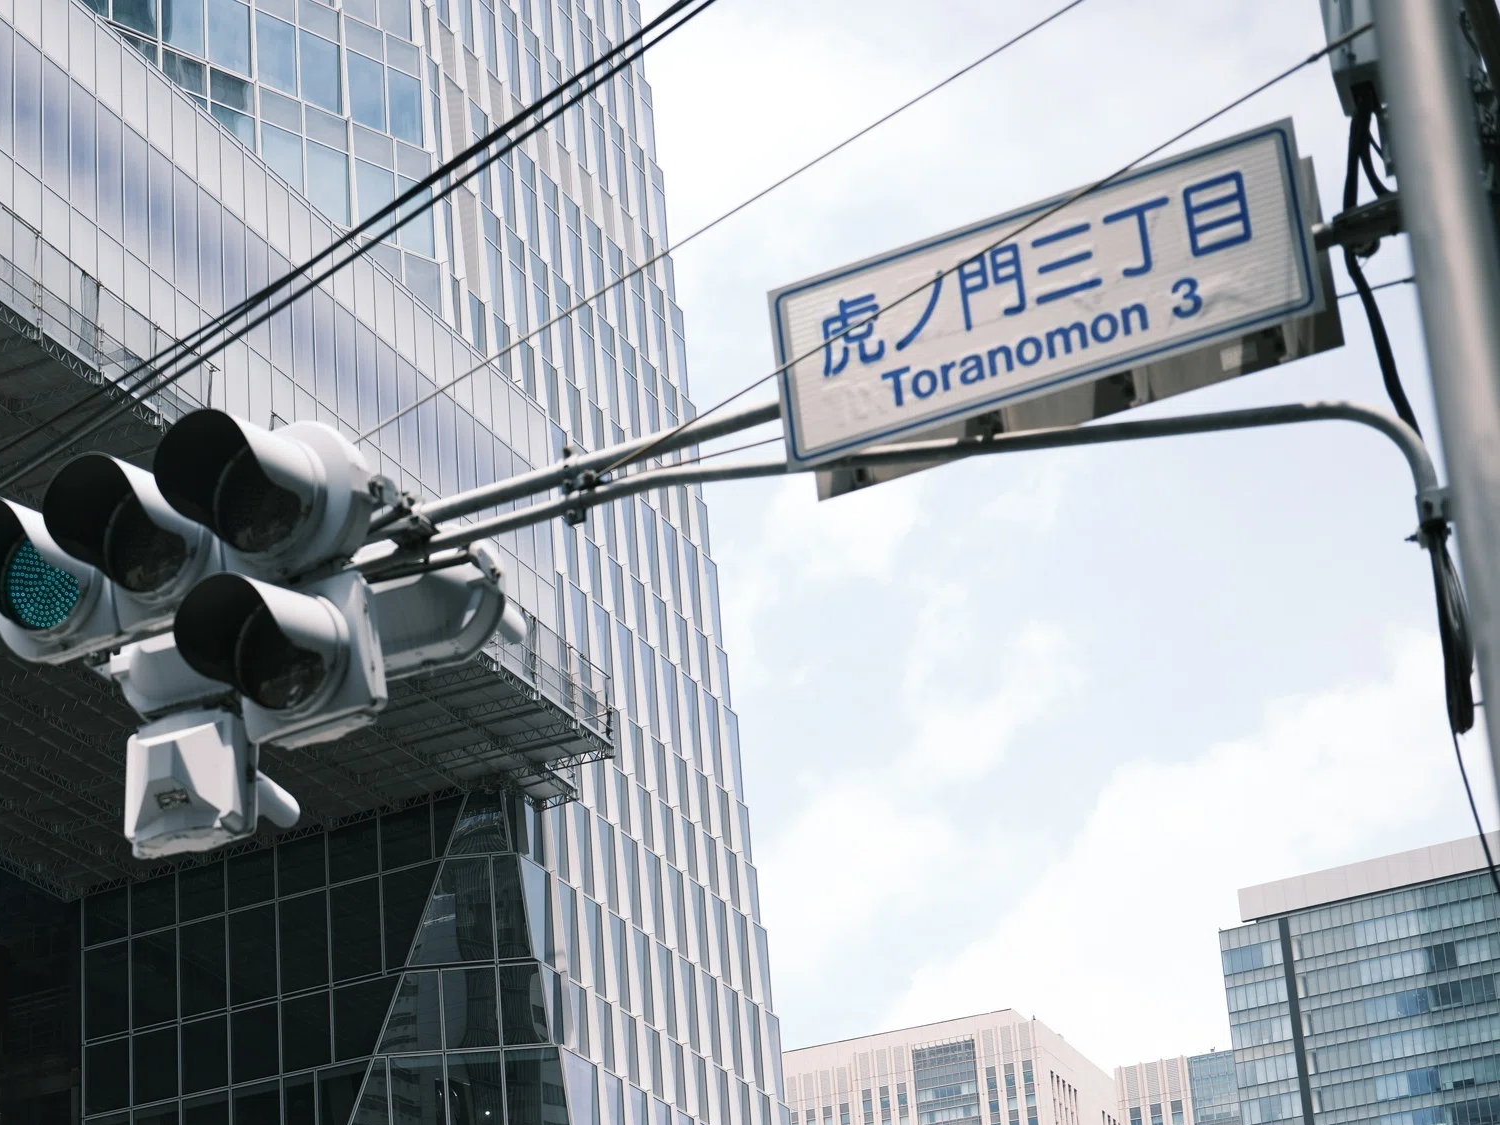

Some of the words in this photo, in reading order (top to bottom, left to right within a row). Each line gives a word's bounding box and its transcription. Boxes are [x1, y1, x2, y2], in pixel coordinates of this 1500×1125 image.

[822, 170, 1252, 377] 虎ノ門三丁目
[881, 302, 1149, 408] Toranomon
[1171, 276, 1203, 319] 3
